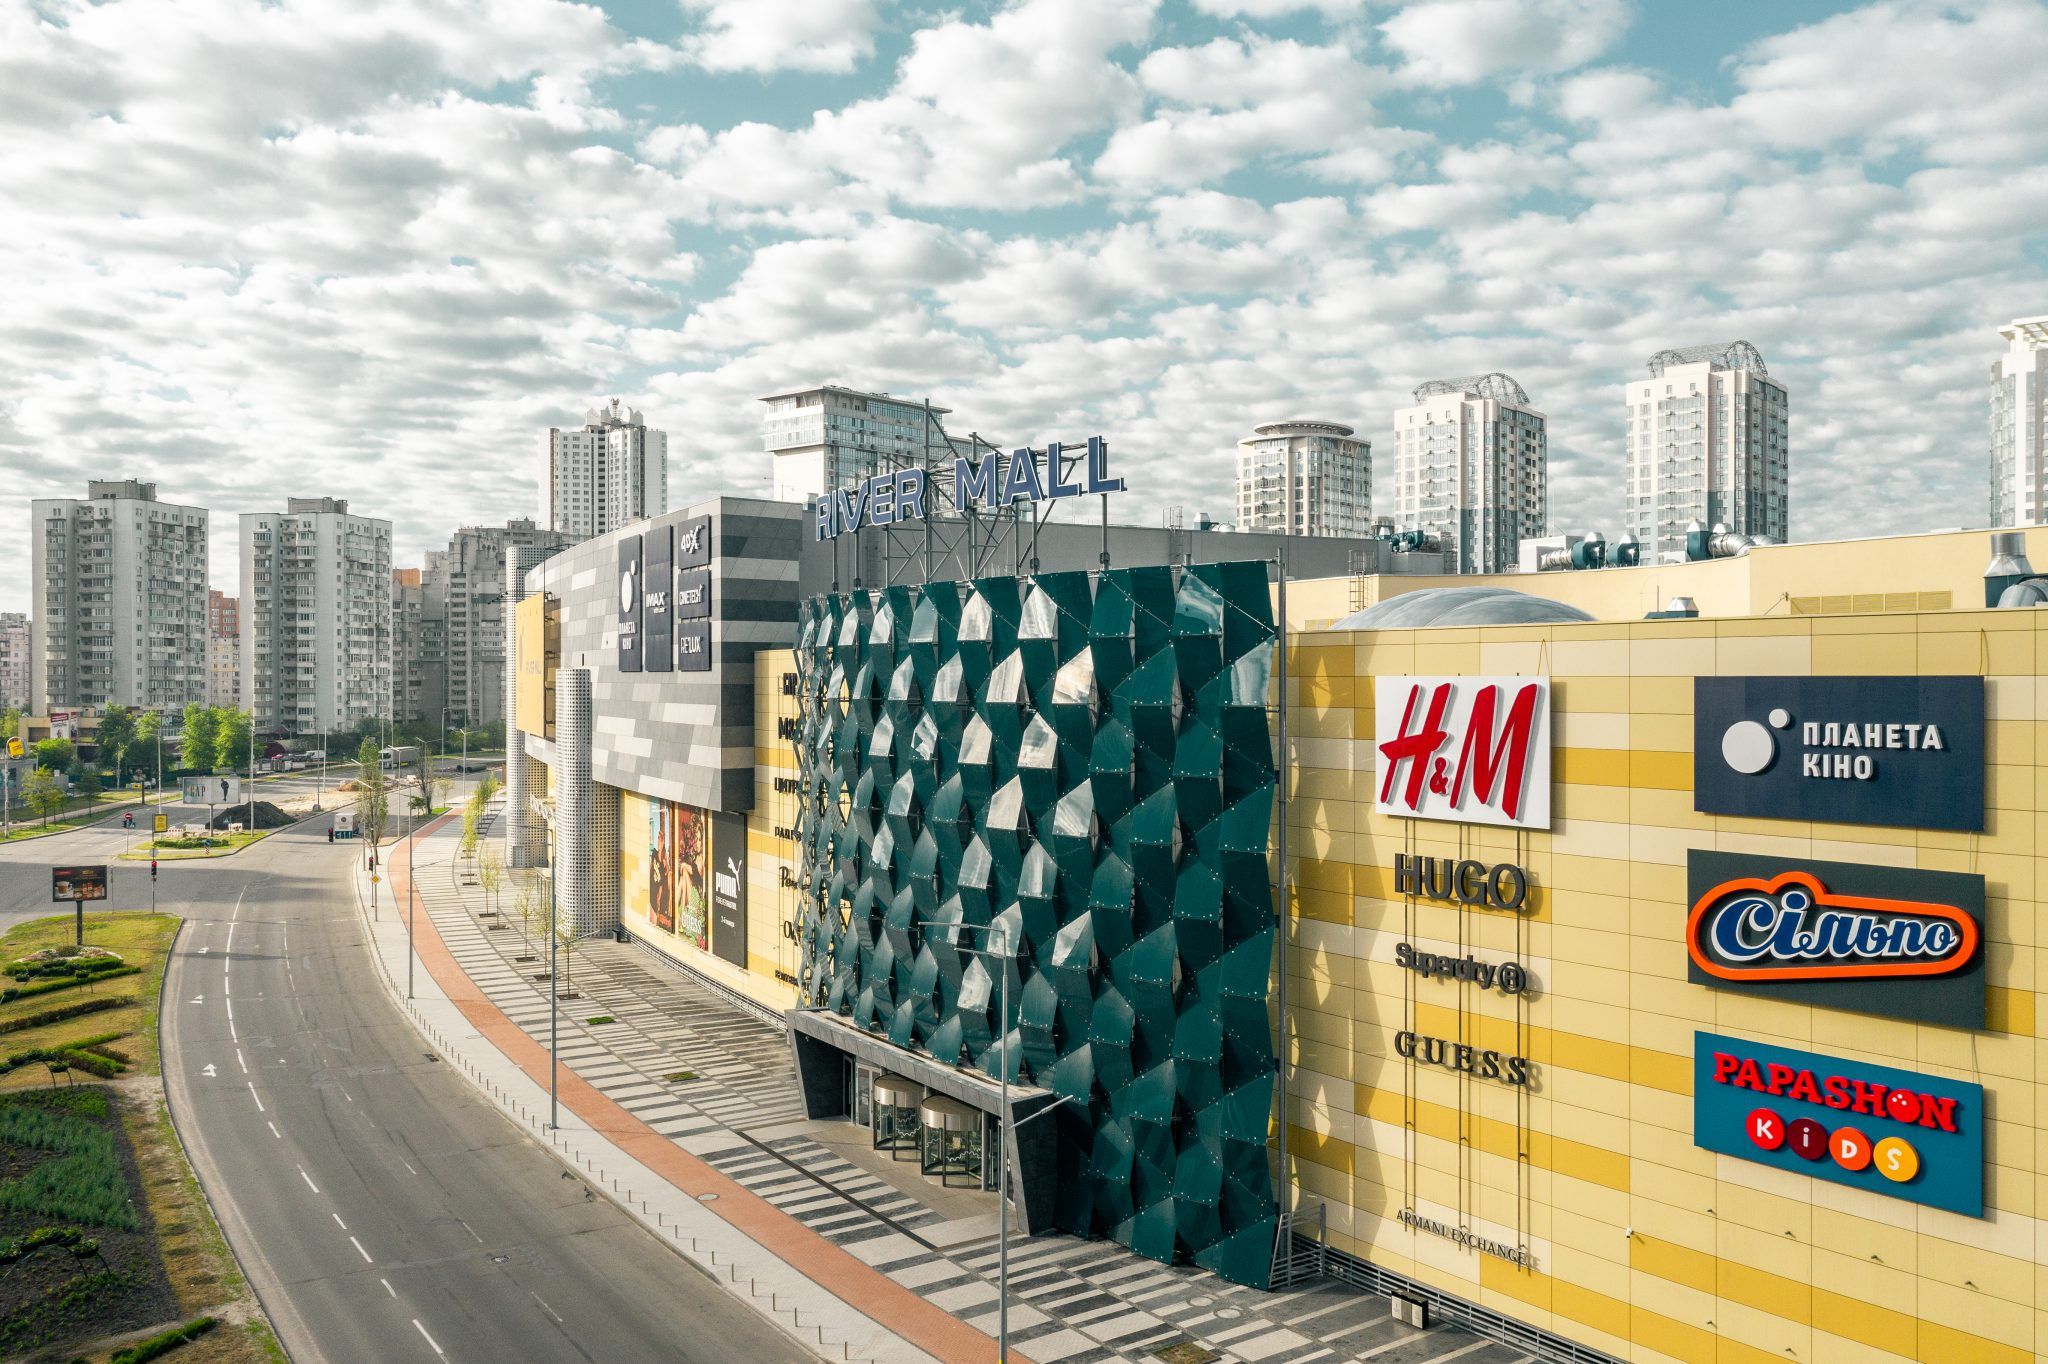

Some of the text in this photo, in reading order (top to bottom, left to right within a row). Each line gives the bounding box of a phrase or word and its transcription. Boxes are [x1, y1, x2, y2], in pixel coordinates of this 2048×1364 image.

[816, 436, 1127, 542] RIVER MALL
[1379, 682, 1539, 820] H&M
[1803, 721, 1944, 750] ПЛАНЕТА
[1803, 753, 1874, 780] КІНО
[1394, 852, 1526, 911] HUGO
[1710, 890, 1960, 962] Сільпо
[1394, 1030, 1526, 1085] GUESS
[1713, 1051, 1957, 1133] PAPASHON
[1396, 1209, 1528, 1266] ARMANI EXCHANGE
